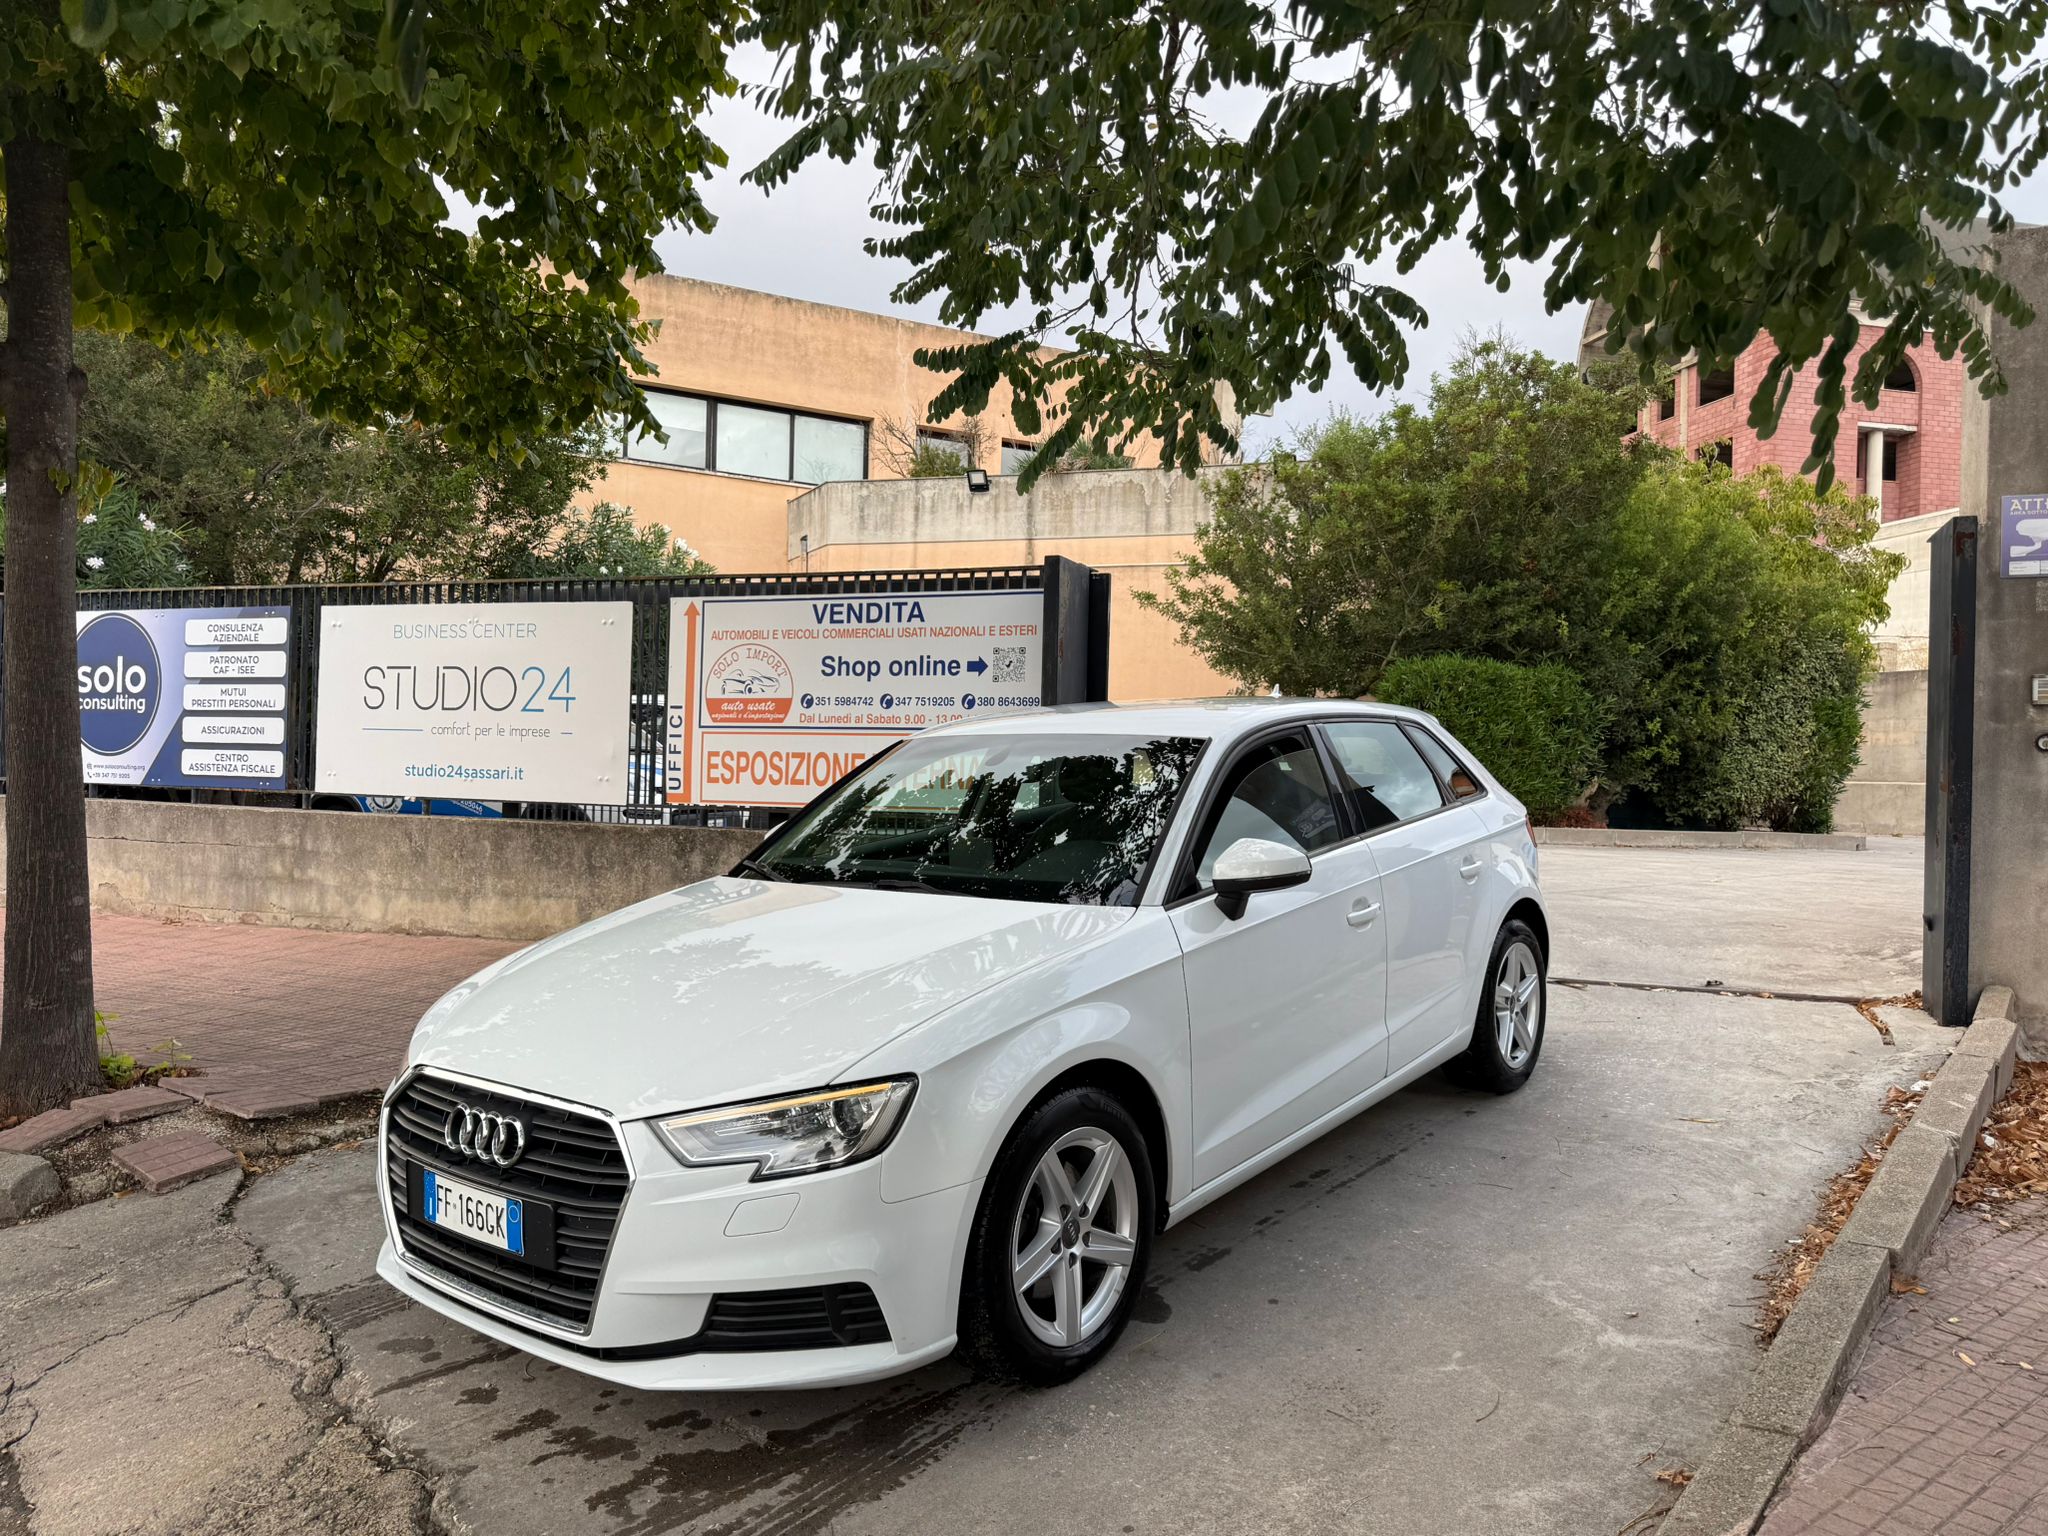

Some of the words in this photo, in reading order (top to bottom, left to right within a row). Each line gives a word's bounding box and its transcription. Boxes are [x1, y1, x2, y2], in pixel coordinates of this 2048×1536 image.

[812, 601, 925, 625] VENDITA
[207, 623, 264, 633] CONSULENZA
[393, 624, 467, 639] BUSINESS
[472, 623, 537, 638] CENTER
[711, 629, 769, 641] AUTOMOBILI
[772, 629, 778, 640] E
[781, 628, 820, 640] VEICOLI
[822, 627, 894, 640] COMMERCIALI
[897, 626, 927, 638] USATI
[929, 626, 986, 638] NAZIONALI
[989, 625, 996, 637] E
[999, 625, 1037, 637] ESTERI
[213, 633, 259, 643] AZIENDALE
[209, 656, 260, 665] PATRONATO
[713, 651, 740, 679] SOLO
[745, 647, 788, 677] IMPORT
[213, 666, 230, 675] CAF
[237, 665, 256, 674] ISEE
[820, 655, 881, 682] Shop
[889, 654, 961, 677] online
[77, 655, 147, 694] solo
[220, 687, 247, 697] MUTUI
[363, 665, 577, 713] STUDIO24
[79, 694, 146, 713] consulting
[191, 699, 227, 708] PRESTITI
[229, 699, 276, 708] PERSONALI
[721, 701, 745, 711] auto
[747, 701, 776, 711] usate
[815, 696, 831, 706] 351
[834, 696, 874, 707] 5984742
[895, 696, 912, 707] 347
[915, 696, 955, 707] 7519205
[977, 696, 995, 707] 380
[998, 696, 1040, 707] 8643699
[799, 713, 815, 723] Dal
[854, 714, 864, 724] al
[866, 713, 901, 725] Sabato
[904, 714, 926, 725] 9.00
[201, 726, 265, 736] ASSICURAZIONI
[431, 721, 472, 736] comfort
[474, 726, 493, 741] per
[496, 723, 506, 737] le
[509, 724, 550, 742] imprese
[668, 705, 683, 790] UFFICI
[214, 753, 249, 763] CENTRO
[189, 763, 239, 773] ASSISTENZA
[241, 764, 276, 774] FISCALE
[405, 764, 524, 781] studio24sassari.it
